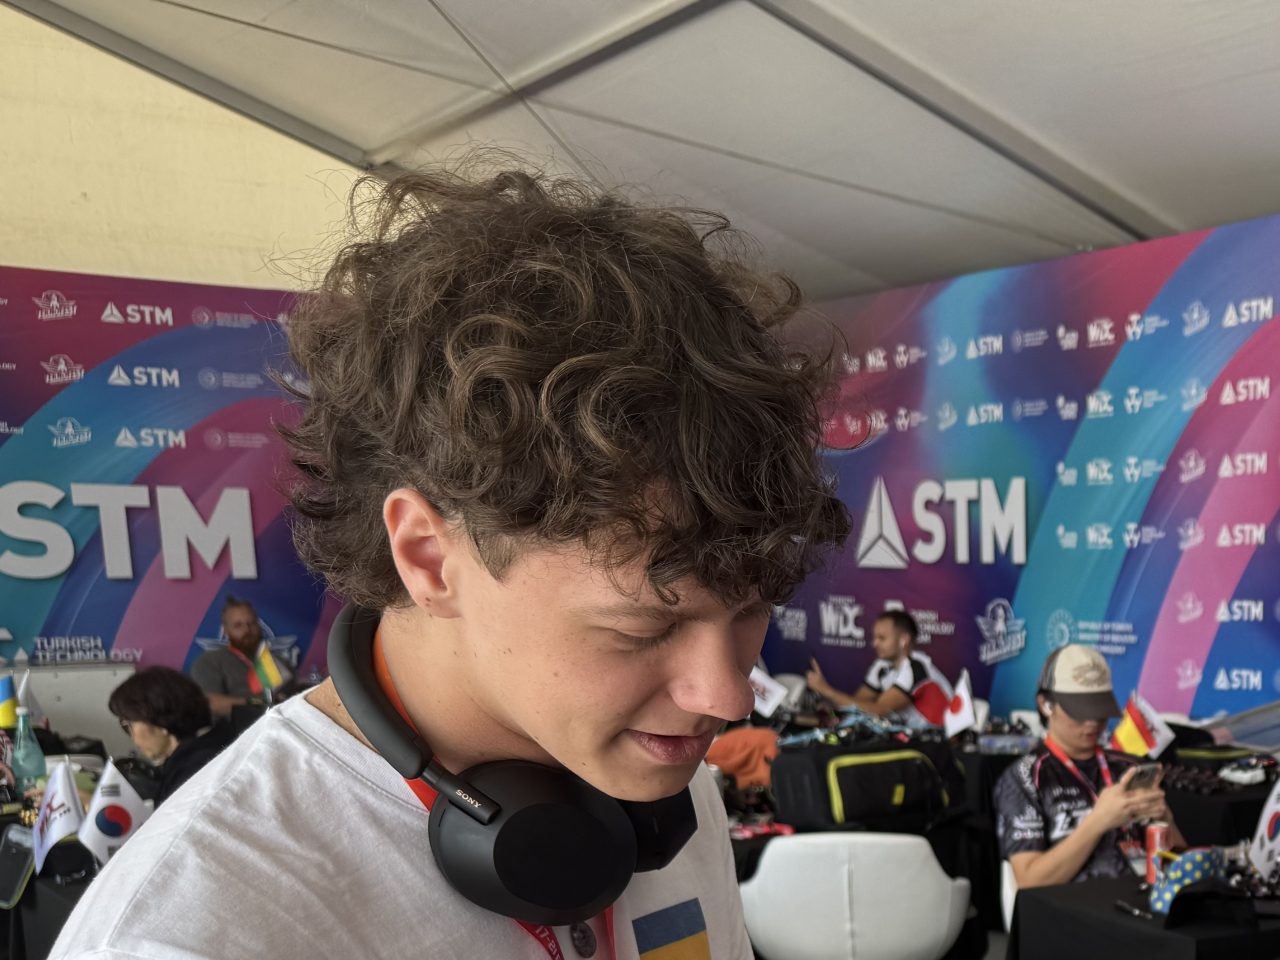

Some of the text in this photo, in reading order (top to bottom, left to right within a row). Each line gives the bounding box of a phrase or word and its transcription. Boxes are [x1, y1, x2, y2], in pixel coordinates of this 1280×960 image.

[126, 304, 174, 326] STM
[1239, 296, 1273, 323] STM
[133, 367, 179, 388] STM
[1236, 375, 1270, 402] STM
[139, 427, 186, 448] STM
[1234, 451, 1268, 476] STM
[0, 480, 257, 580] STM
[911, 477, 1027, 565] STM
[1232, 523, 1266, 545] STM
[1231, 599, 1264, 621] STM
[35, 636, 102, 651] TURKISH
[36, 648, 143, 663] TECHNOLOGY
[1231, 669, 1262, 691] STM
[455, 789, 482, 808] SONY
